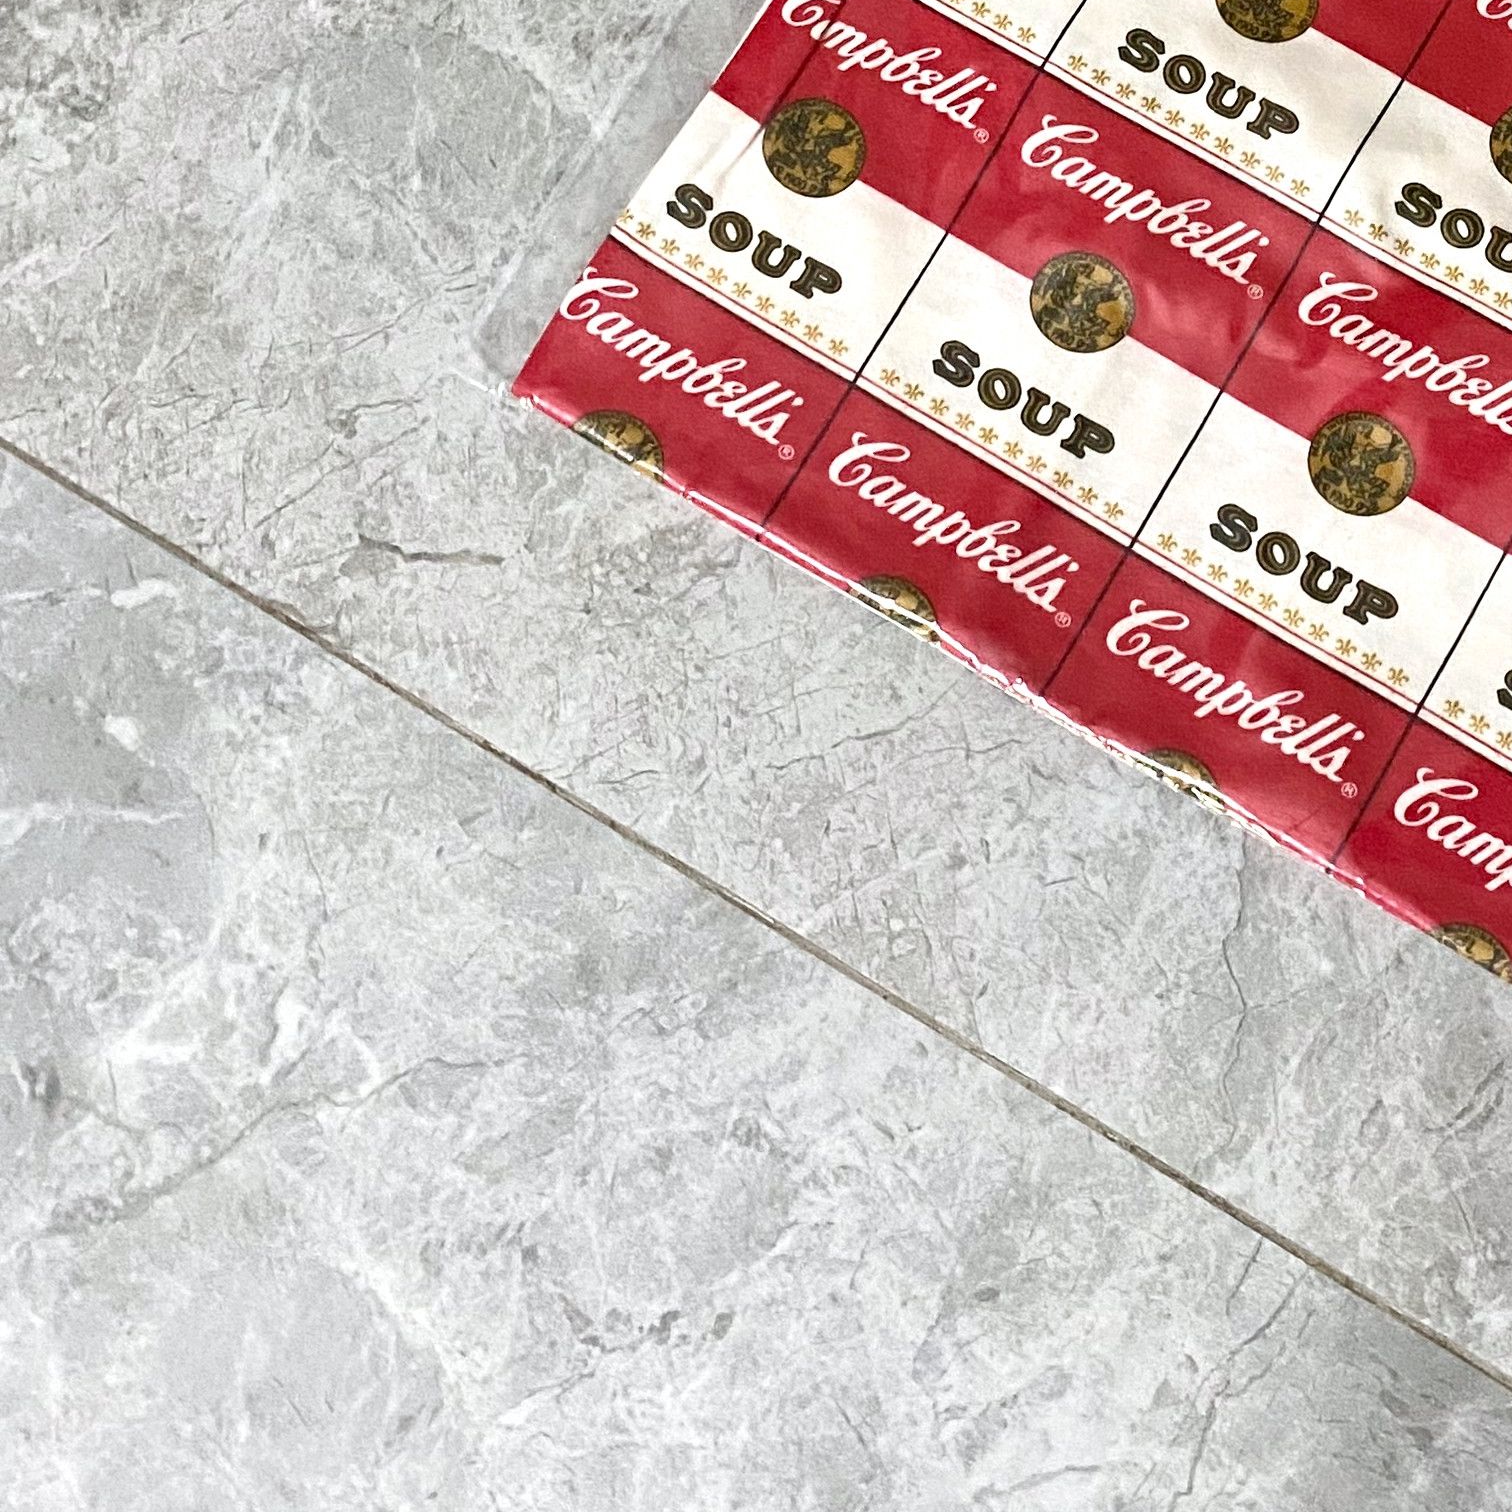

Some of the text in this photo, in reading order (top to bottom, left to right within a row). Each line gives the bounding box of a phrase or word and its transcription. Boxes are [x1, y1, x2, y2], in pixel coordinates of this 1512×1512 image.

[1118, 28, 1299, 139] SOUP
[667, 184, 842, 299] SOUP
[1021, 115, 1269, 284] Campbell's
[560, 266, 803, 445] Campbell's
[933, 341, 1115, 459] SOUP
[829, 432, 1079, 612] Campbell's
[1210, 504, 1398, 625] SOUP
[1107, 599, 1364, 782] Campbell's
